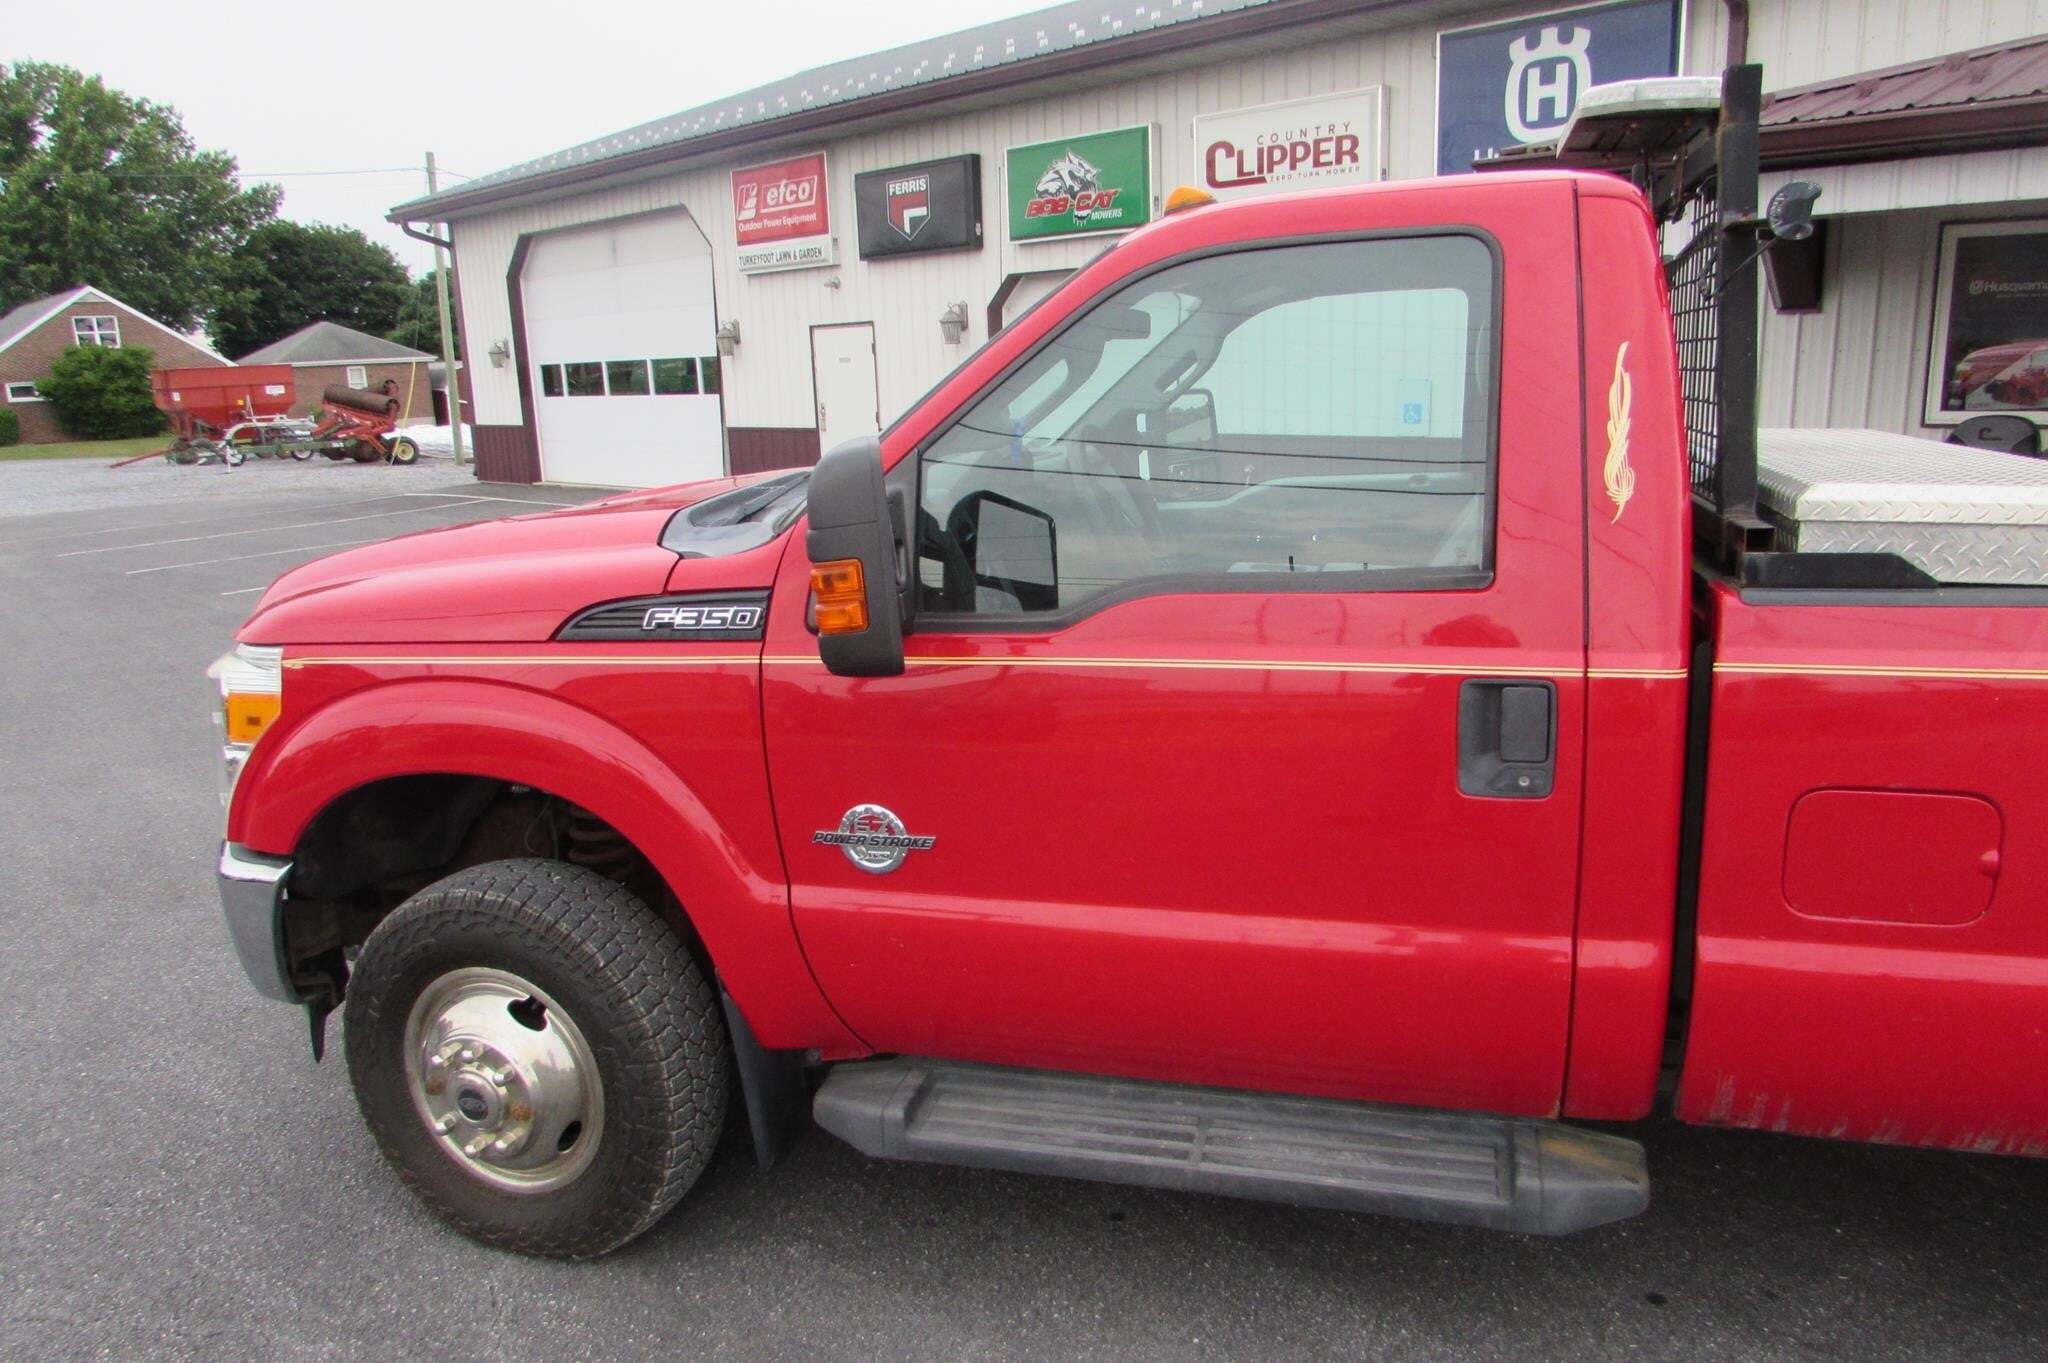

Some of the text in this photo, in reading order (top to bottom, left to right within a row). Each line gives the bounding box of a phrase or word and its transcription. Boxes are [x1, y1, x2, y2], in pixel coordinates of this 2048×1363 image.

[1256, 121, 1351, 146] COUNTRY
[1205, 133, 1360, 189] CLIPPER
[1326, 166, 1360, 176] MOWER
[766, 178, 811, 206] efco
[889, 178, 927, 196] FERRIS
[738, 212, 817, 232] Outdoor Power Equipment
[1091, 208, 1123, 220] MOWERS
[738, 251, 775, 266] TURKEYFOOT
[776, 248, 792, 262] LAWN
[799, 246, 823, 259] GARDEN
[1984, 280, 2048, 294] Husqvarn
[811, 831, 937, 850] POWER STROKE
